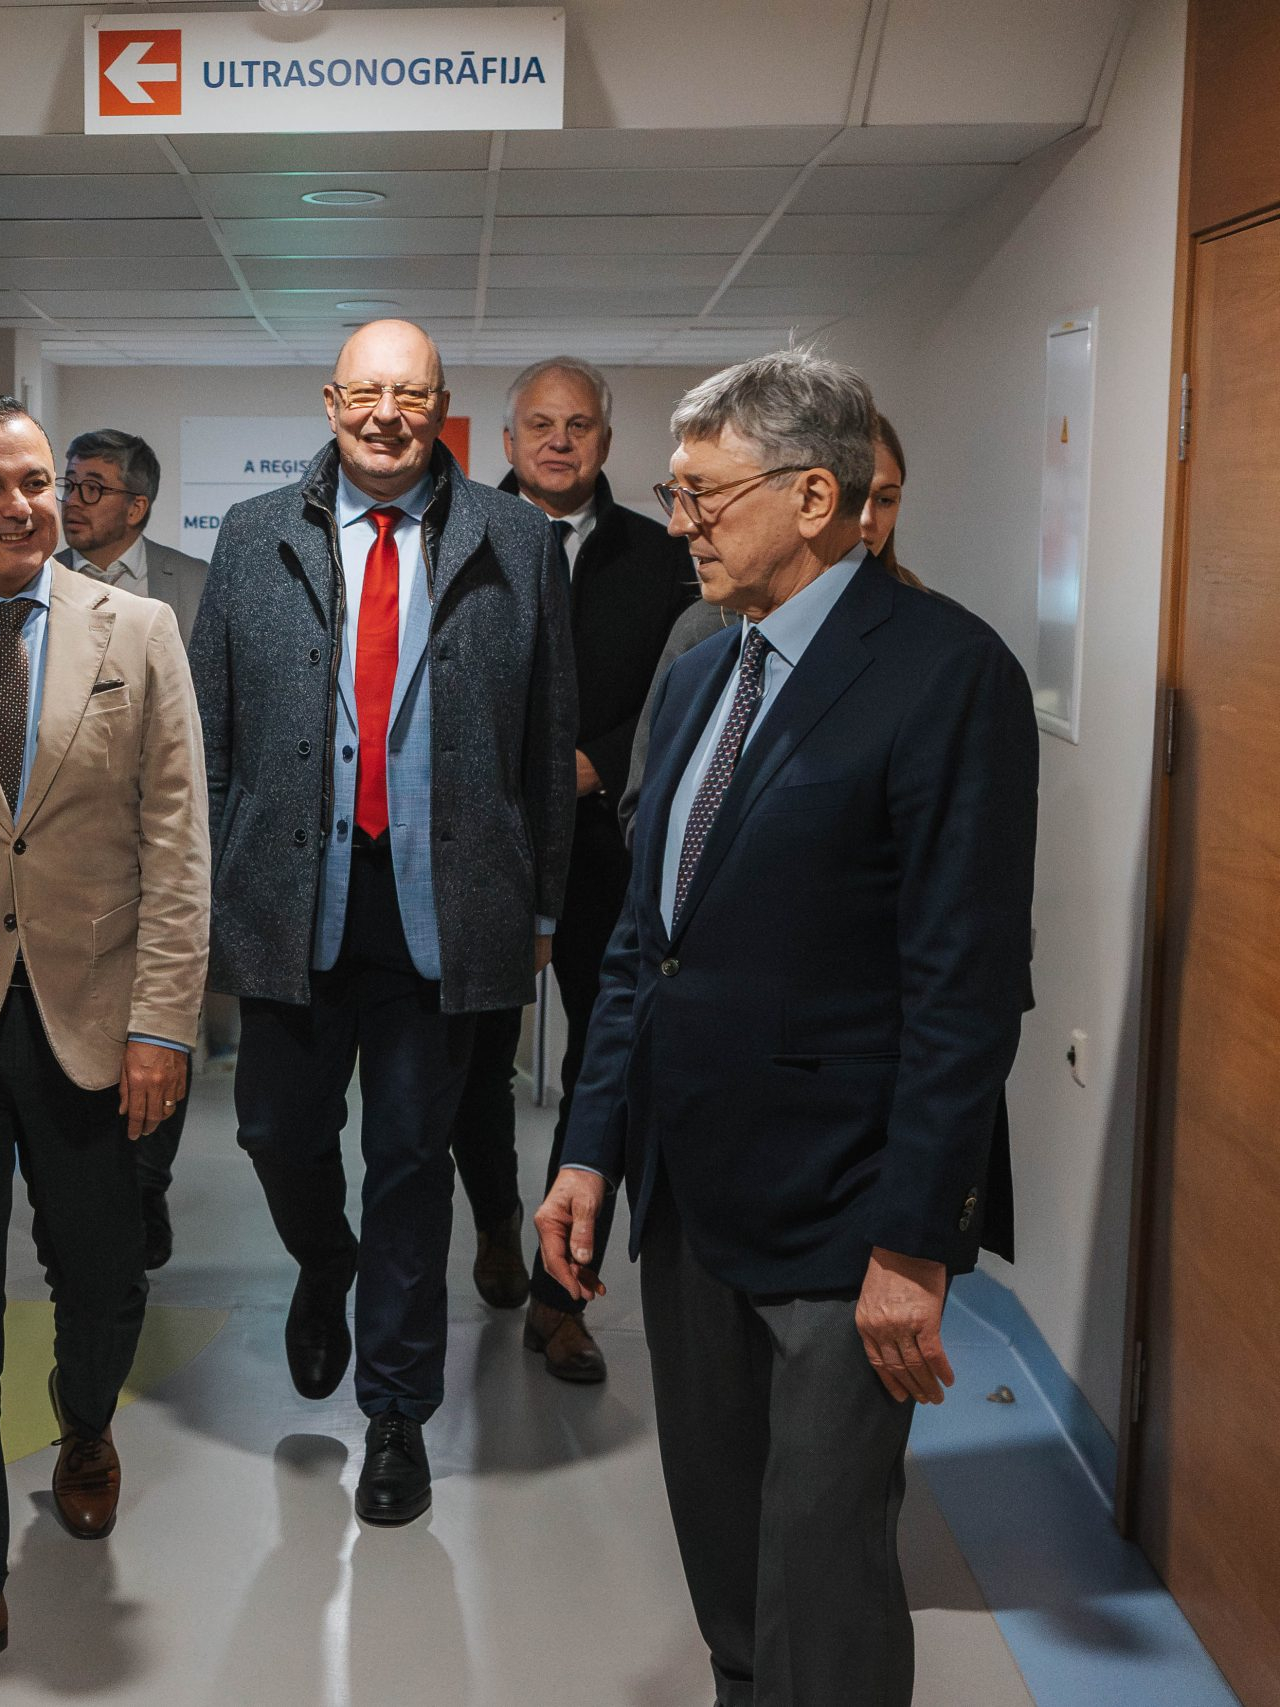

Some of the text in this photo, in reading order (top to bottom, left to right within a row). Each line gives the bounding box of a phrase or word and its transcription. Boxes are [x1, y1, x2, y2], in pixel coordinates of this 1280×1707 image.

[203, 51, 546, 88] ULTRASONOGRĀFIJA
[244, 460, 314, 478] A REĢIS
[184, 516, 224, 529] MED
